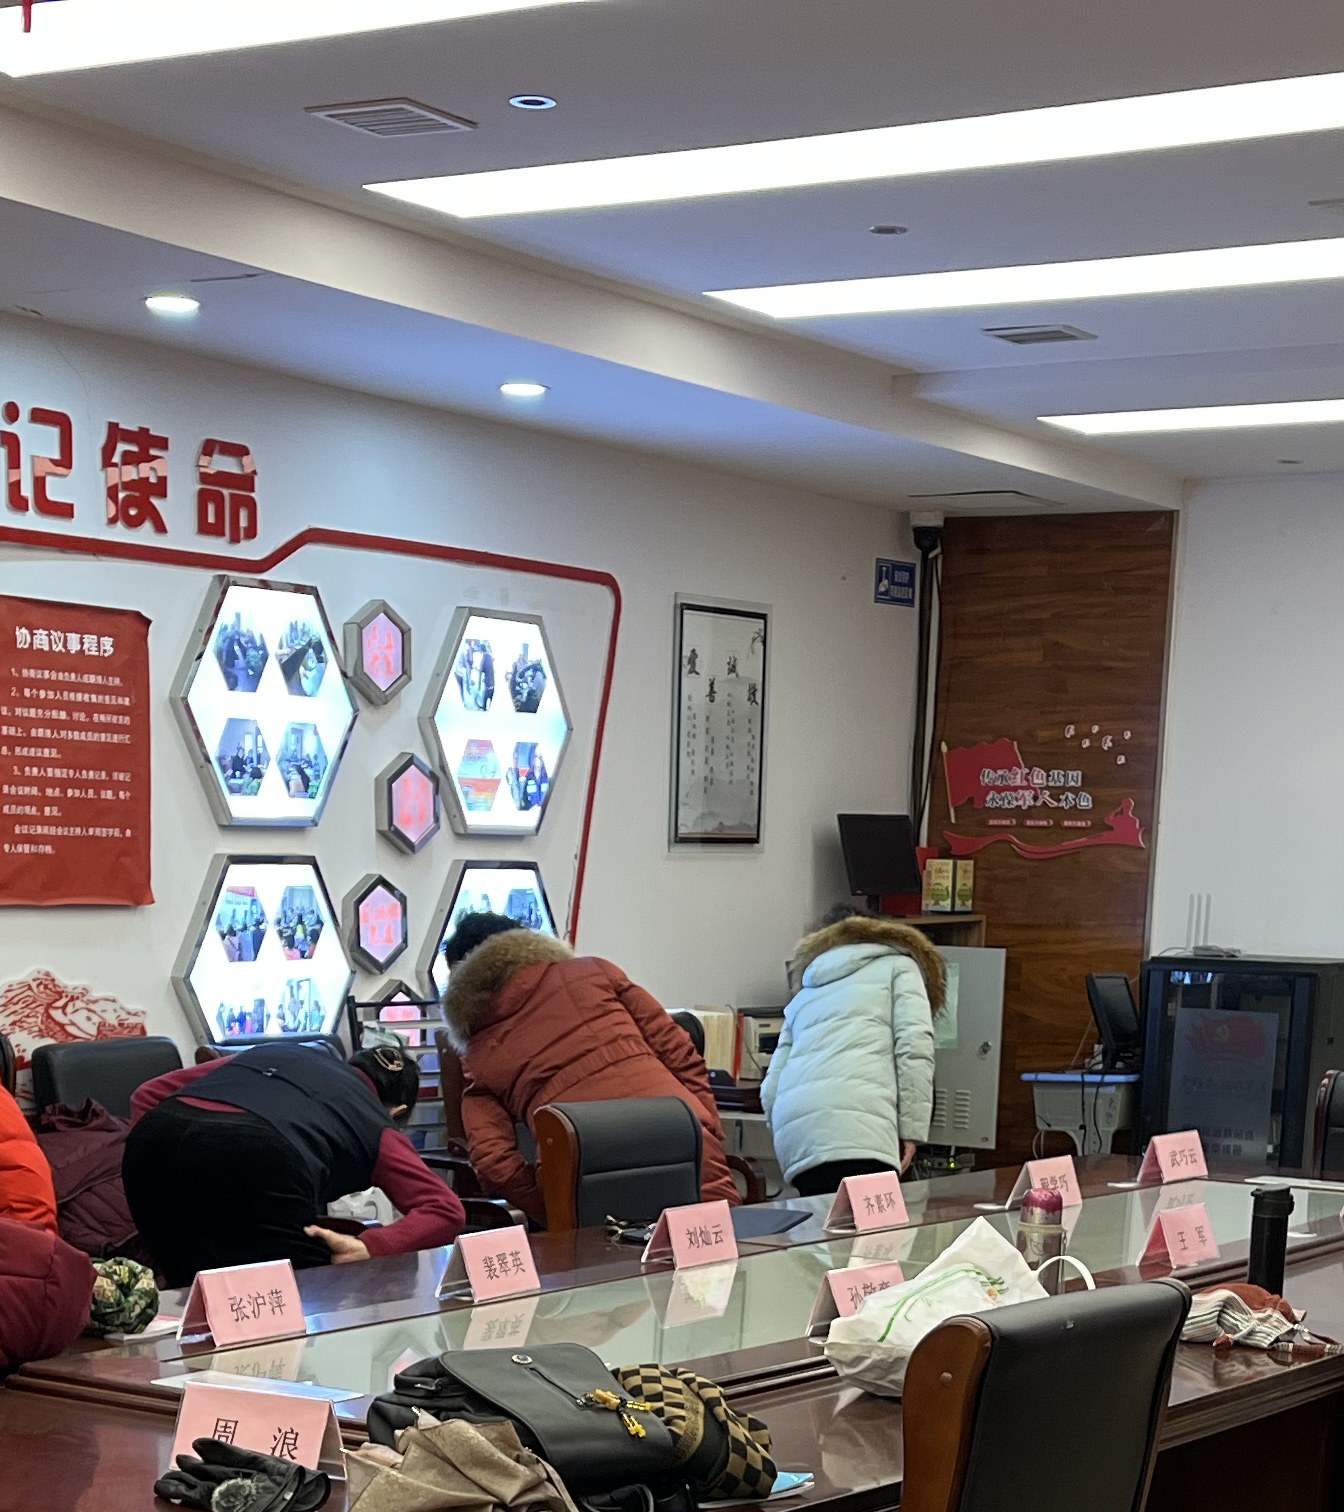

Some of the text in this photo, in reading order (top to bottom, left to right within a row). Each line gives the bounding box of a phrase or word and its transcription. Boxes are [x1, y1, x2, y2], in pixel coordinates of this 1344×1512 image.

[15, 626, 115, 657] 协商议事程序
[980, 766, 1082, 787] 传承红色基因
[685, 1224, 724, 1249] 刘灿云
[482, 1250, 526, 1280] 裴翠英
[228, 1289, 286, 1322] 张沪萍
[212, 1417, 299, 1460] 周浪
